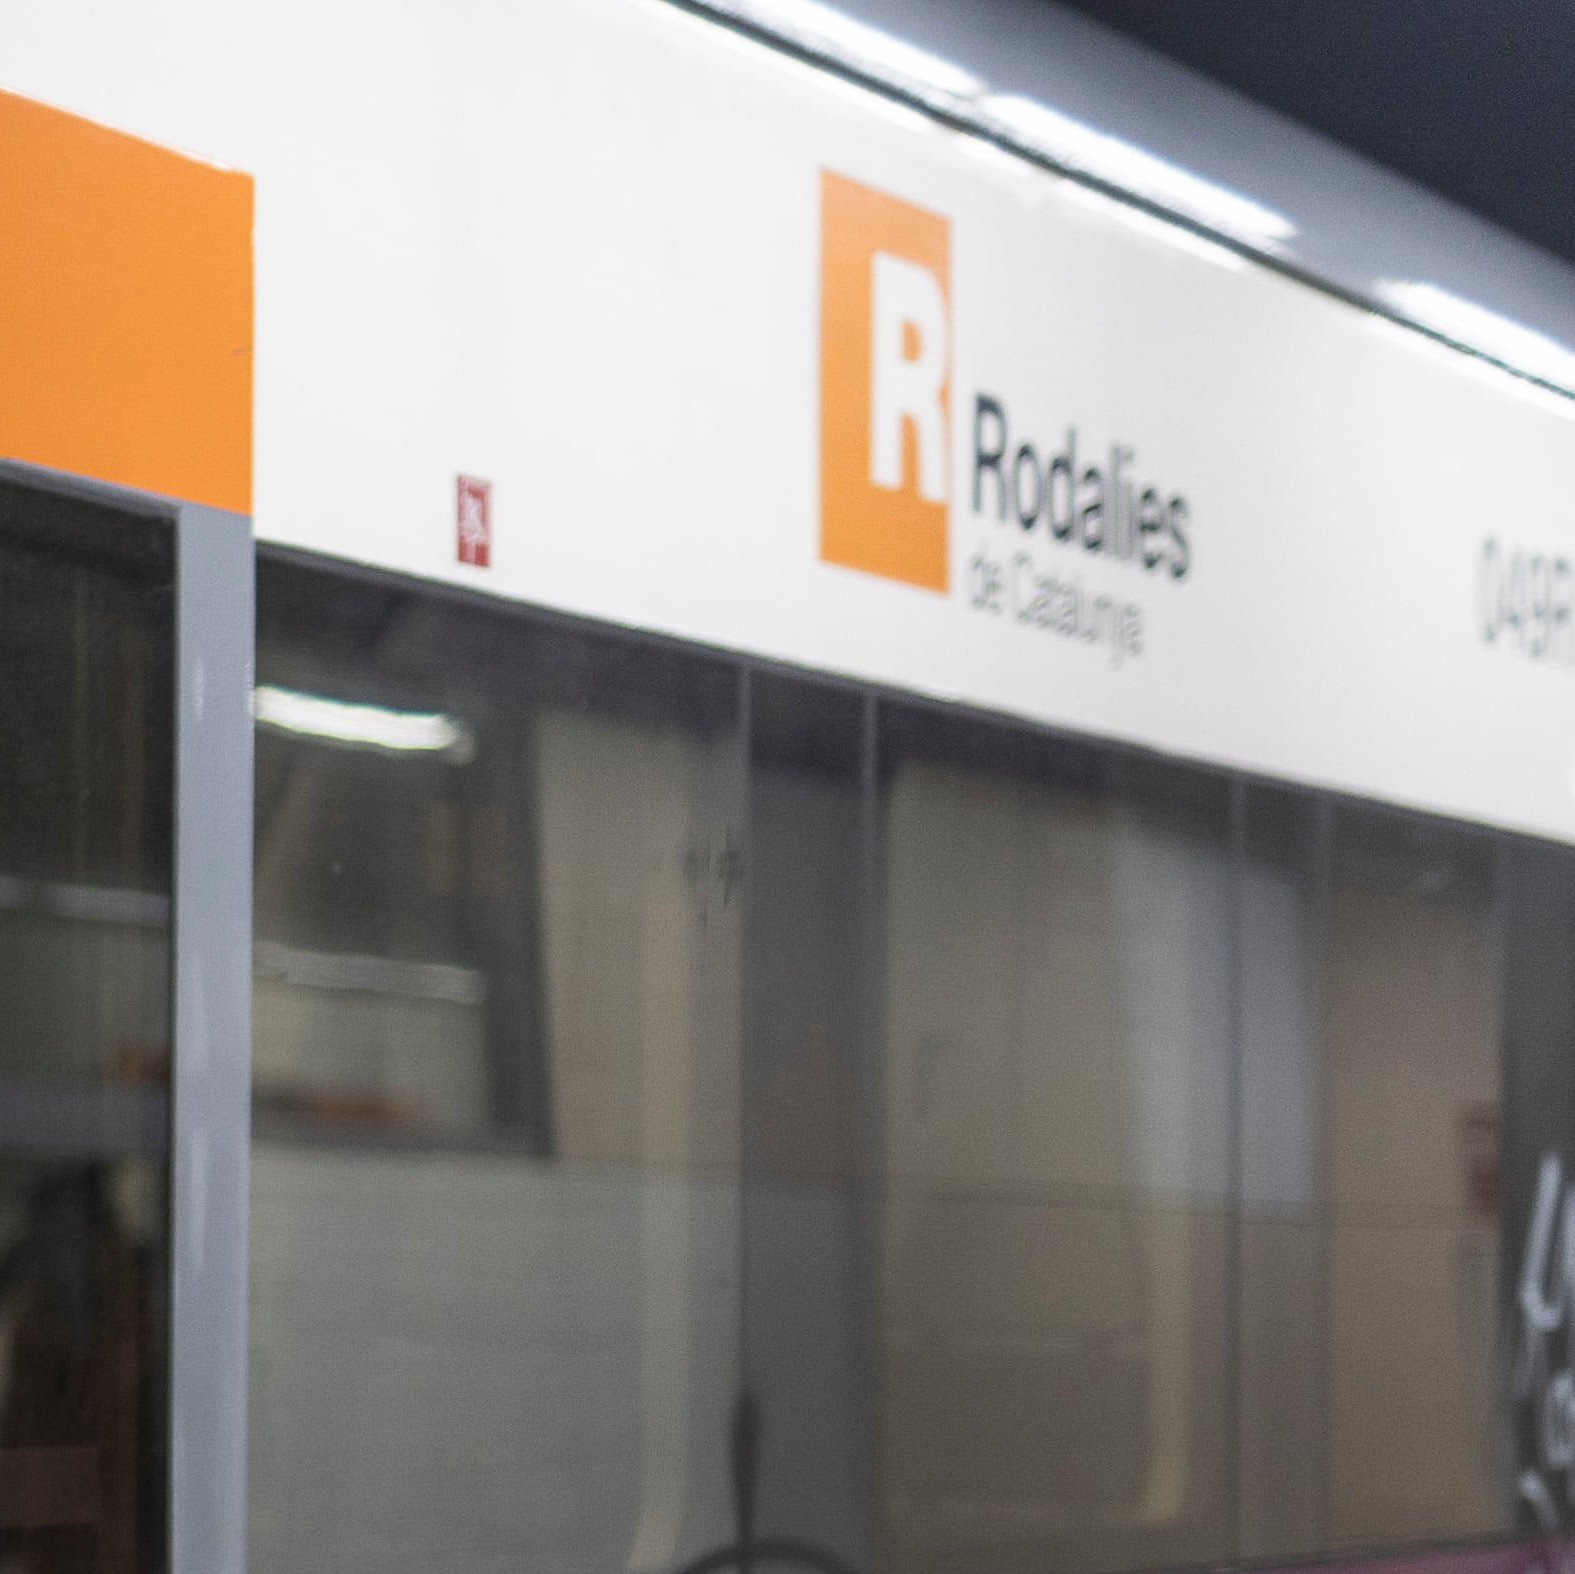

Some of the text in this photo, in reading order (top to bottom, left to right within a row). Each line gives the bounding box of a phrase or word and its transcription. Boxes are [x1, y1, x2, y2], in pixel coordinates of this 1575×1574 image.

[870, 250, 949, 504] R
[972, 390, 1192, 580] Rodalies
[969, 542, 1144, 670] de Catalunya
